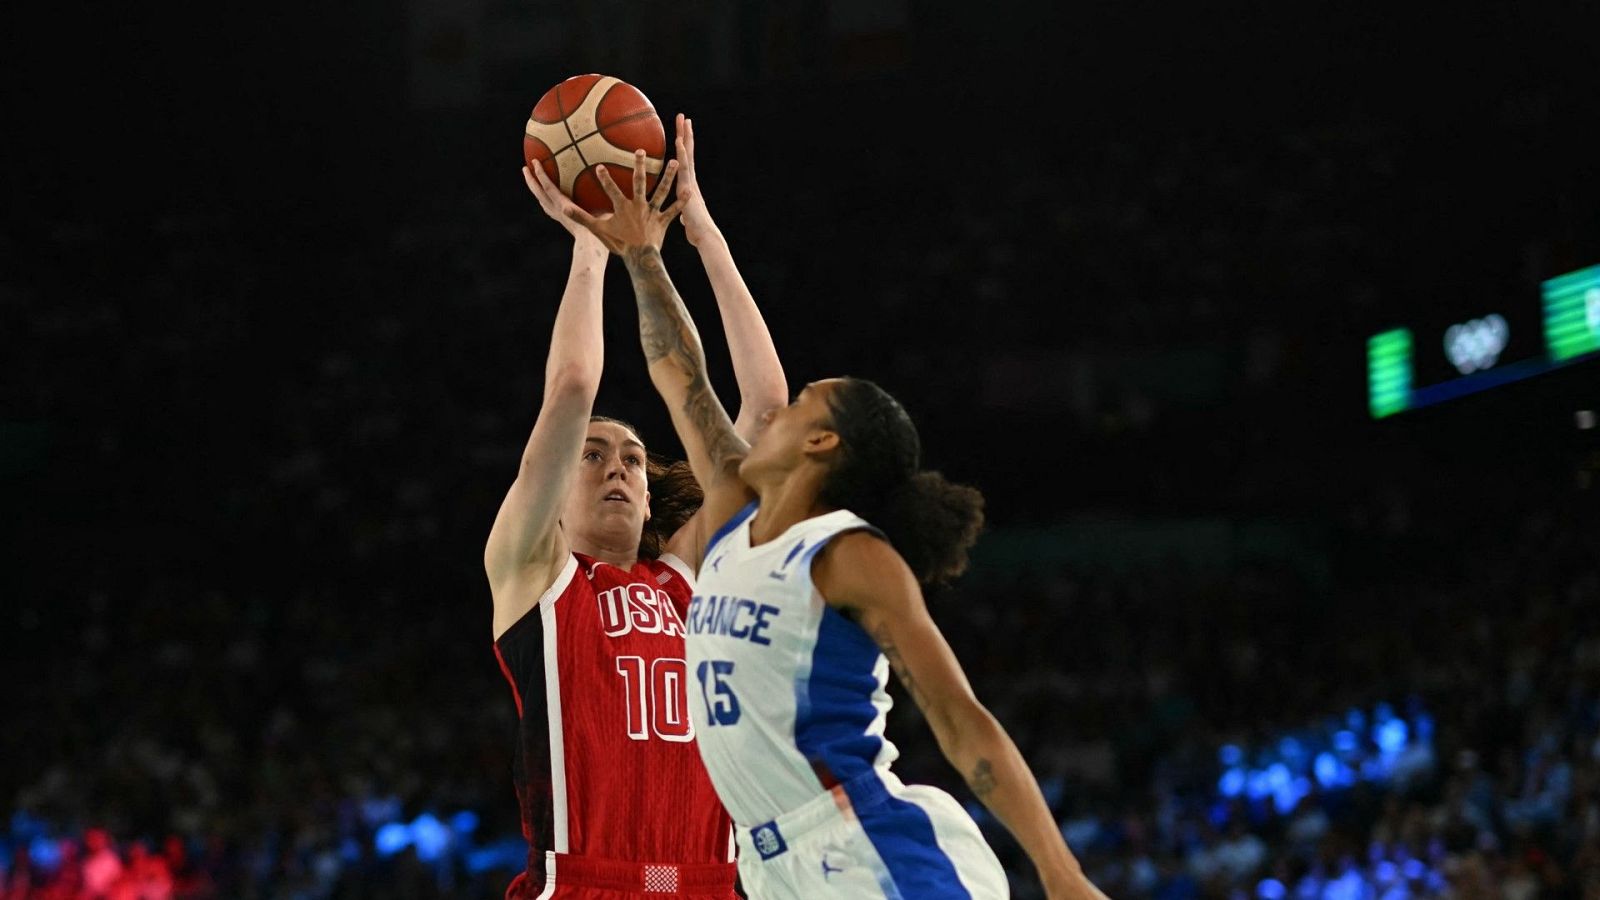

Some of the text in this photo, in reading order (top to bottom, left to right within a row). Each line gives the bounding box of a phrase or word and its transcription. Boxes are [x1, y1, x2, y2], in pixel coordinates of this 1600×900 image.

[598, 583, 687, 638] USA
[686, 595, 780, 646] RANCE
[616, 655, 695, 742] 10
[696, 660, 741, 727] 15
